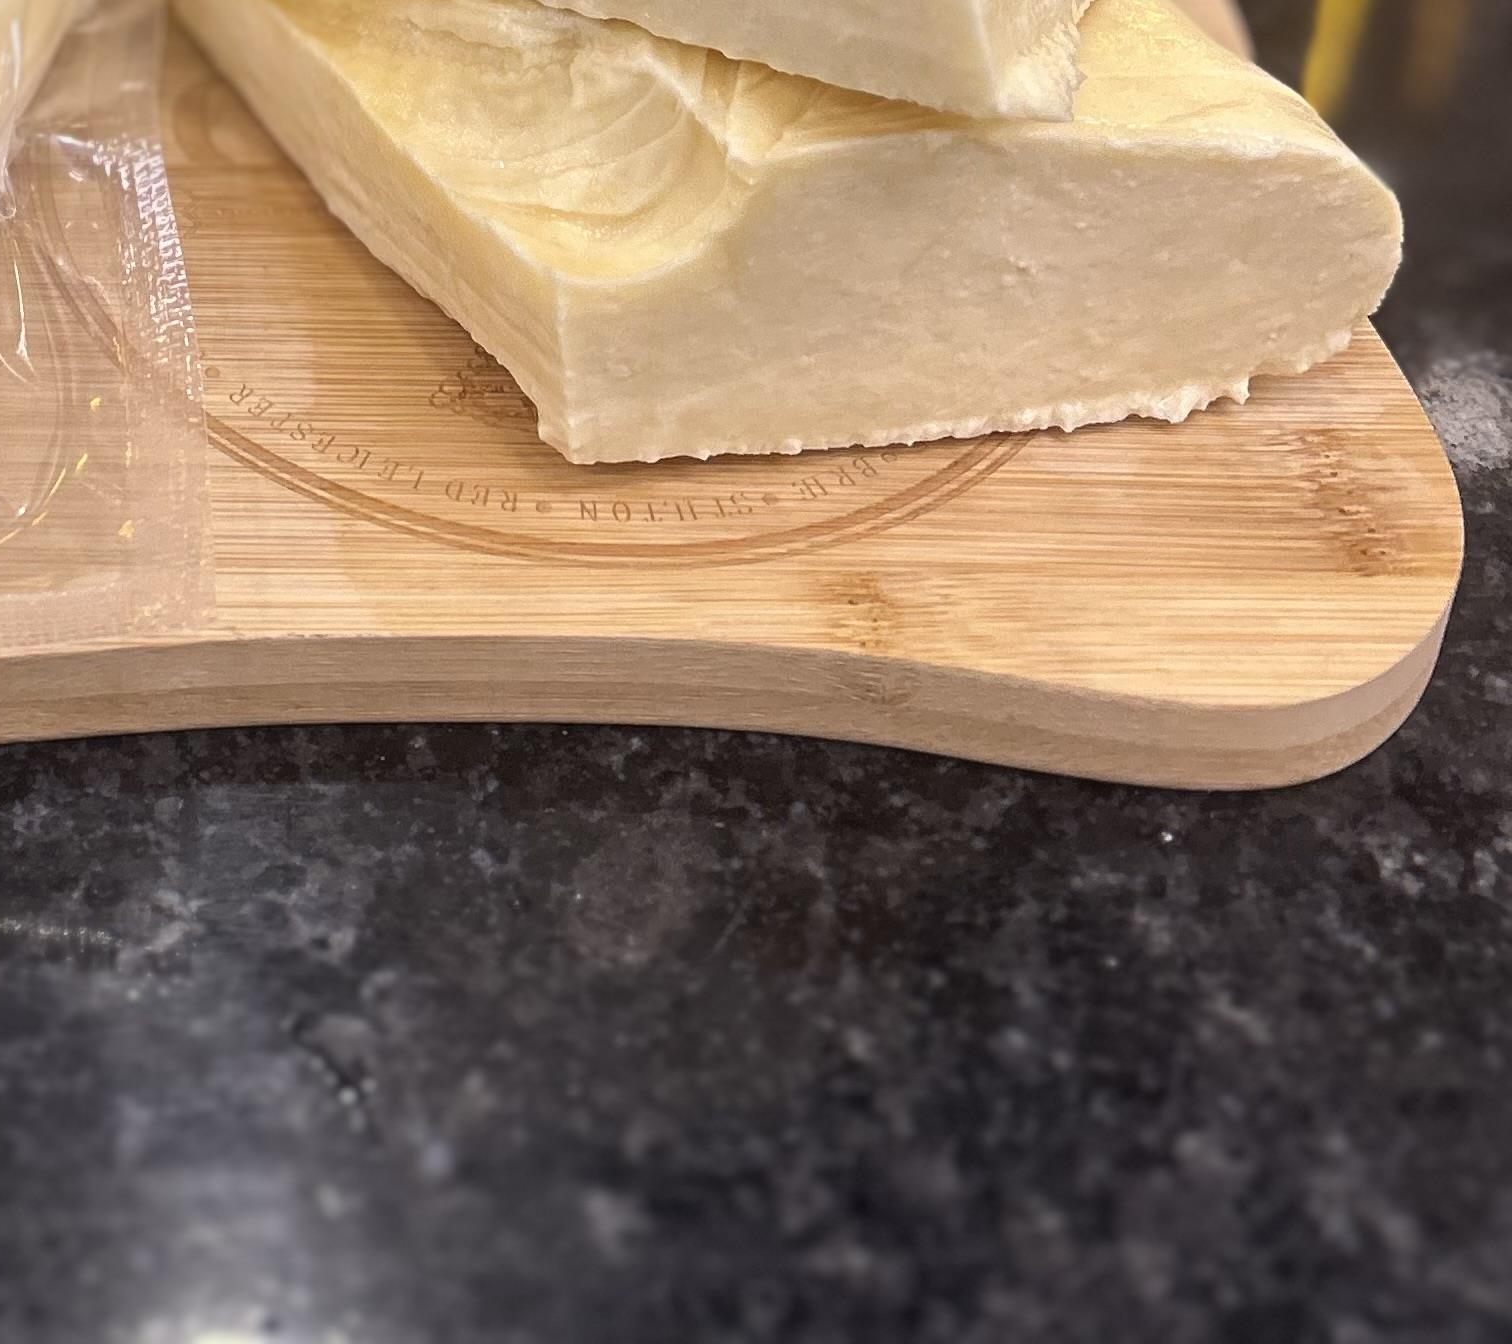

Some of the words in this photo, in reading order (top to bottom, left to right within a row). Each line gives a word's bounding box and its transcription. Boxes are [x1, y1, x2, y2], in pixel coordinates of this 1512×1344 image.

[228, 383, 426, 491] LEICESTER
[445, 480, 519, 514] RED
[792, 455, 879, 501] BRIE
